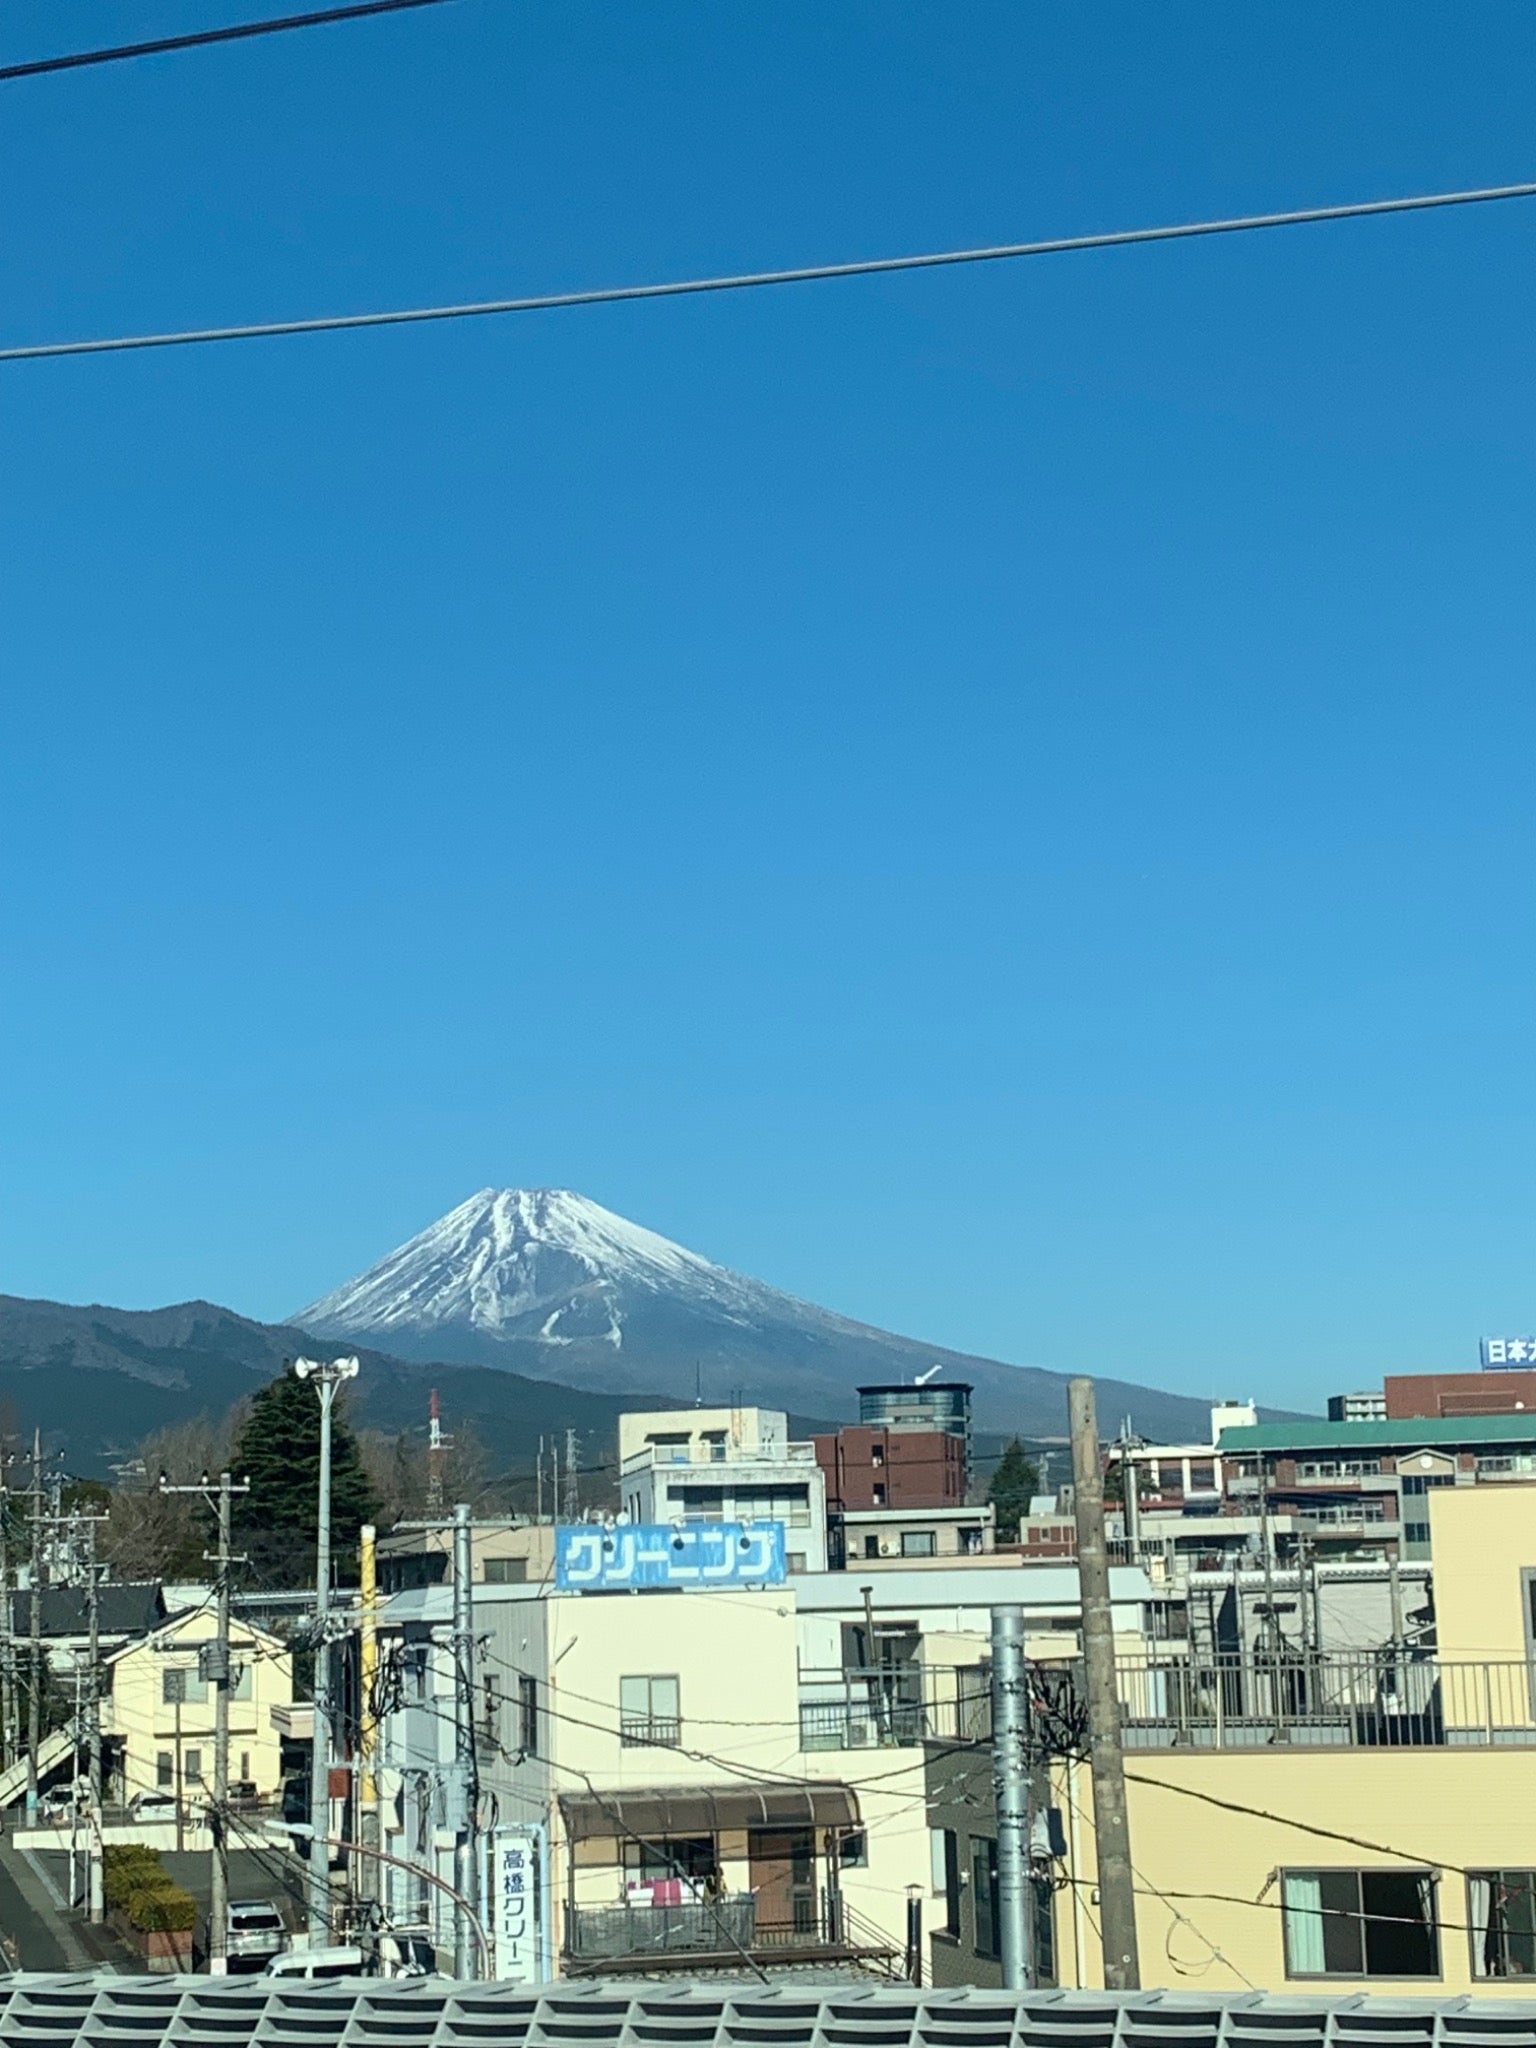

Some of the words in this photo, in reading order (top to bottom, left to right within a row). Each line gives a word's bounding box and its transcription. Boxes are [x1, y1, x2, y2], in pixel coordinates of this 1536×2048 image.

[566, 1531, 773, 1581] クリーニング
